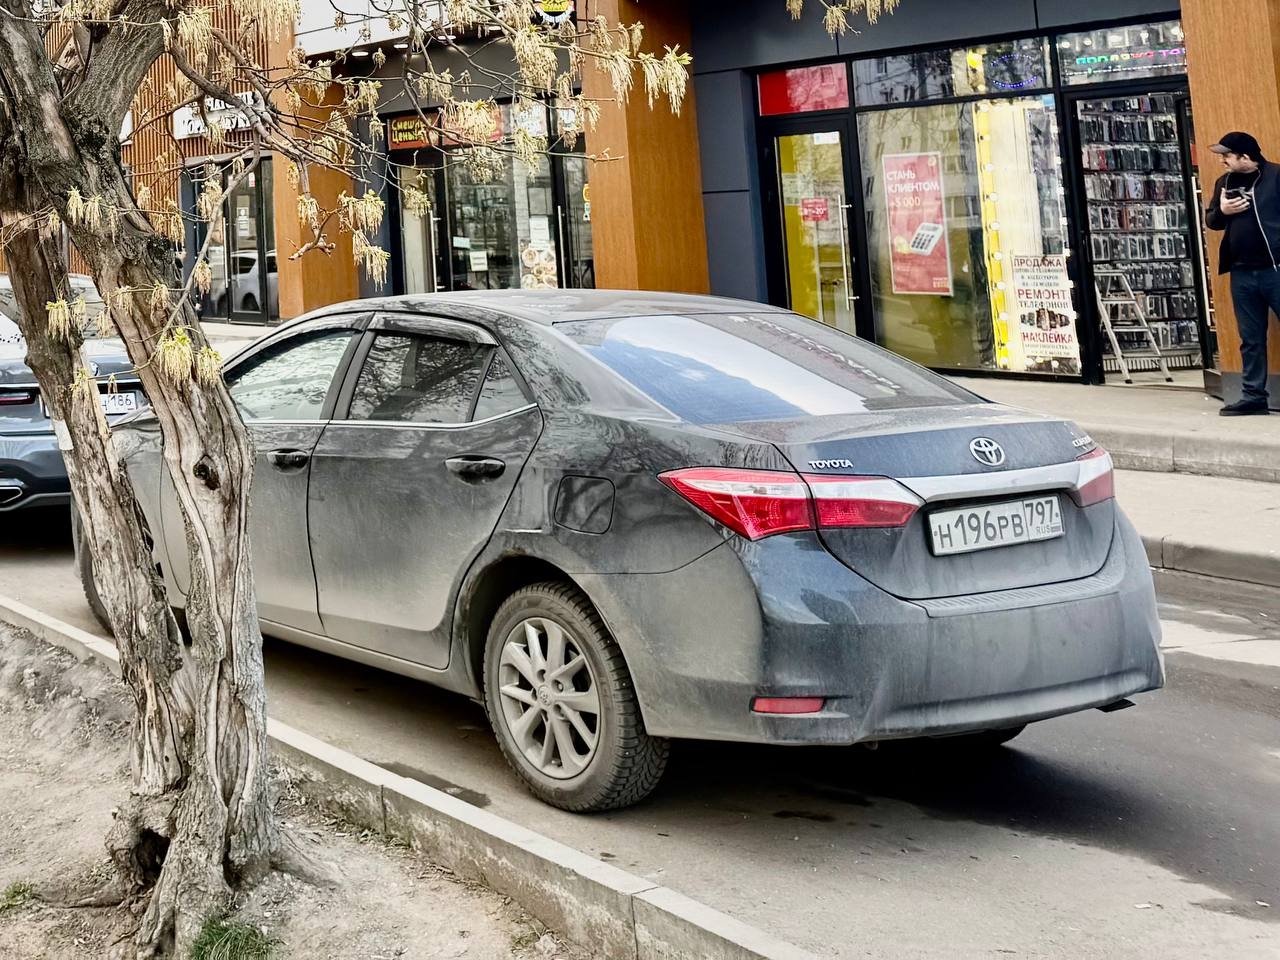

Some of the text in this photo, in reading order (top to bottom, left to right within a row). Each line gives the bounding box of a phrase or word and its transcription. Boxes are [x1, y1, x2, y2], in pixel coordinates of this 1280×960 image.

[886, 170, 916, 181] СТАНЬ
[888, 181, 940, 193] КЛИЕНТОМ
[1014, 258, 1062, 268] ПРОДАЖА
[1017, 289, 1067, 300] РЕМОНТ
[1022, 331, 1073, 344] НАКЛЕЙКА
[808, 459, 854, 470] TOYOTA
